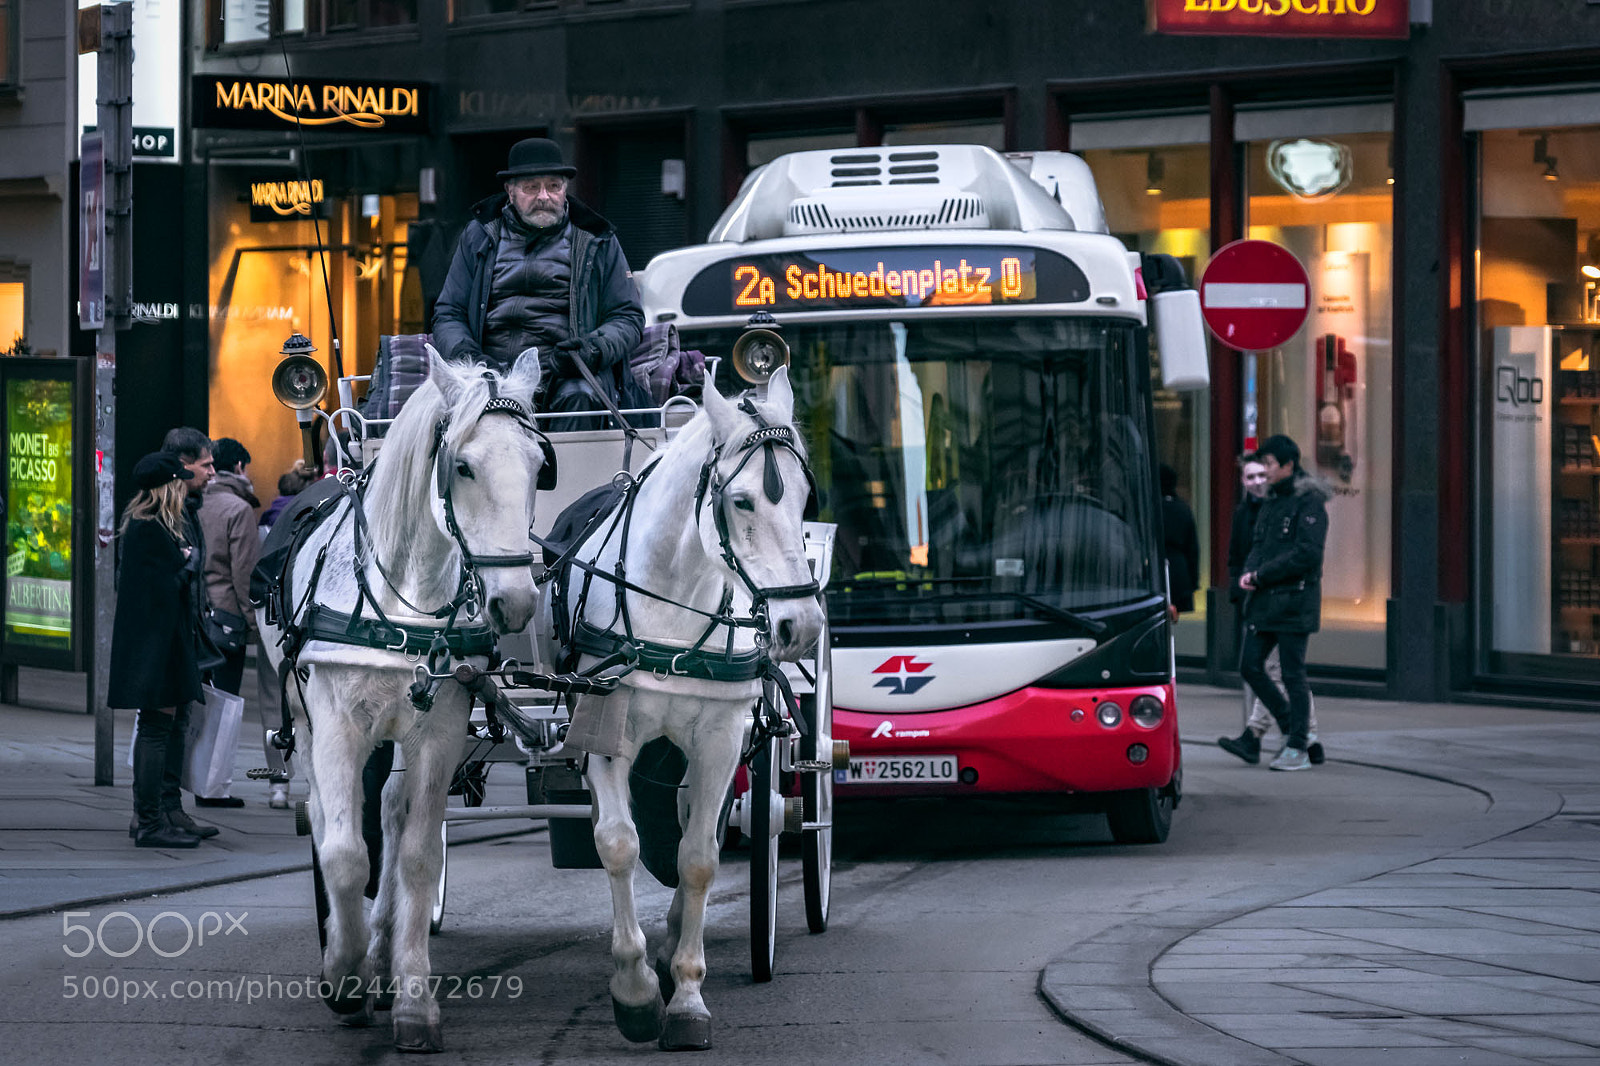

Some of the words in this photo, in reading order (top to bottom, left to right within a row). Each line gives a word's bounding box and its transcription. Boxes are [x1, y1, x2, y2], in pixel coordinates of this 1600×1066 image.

[216, 82, 317, 122] MARINA
[323, 85, 418, 124] RINALDI
[132, 134, 168, 151] HOP
[251, 181, 288, 210] MARINA
[733, 265, 776, 305] 2A
[785, 258, 993, 301] Schwedenplatz
[1497, 365, 1543, 407] Qbo
[10, 432, 48, 457] MONET
[48, 443, 59, 458] BIS
[10, 457, 56, 482] PICASSO
[9, 581, 71, 611] ALBERTINA
[850, 762, 863, 779] W
[878, 761, 925, 778] 2562
